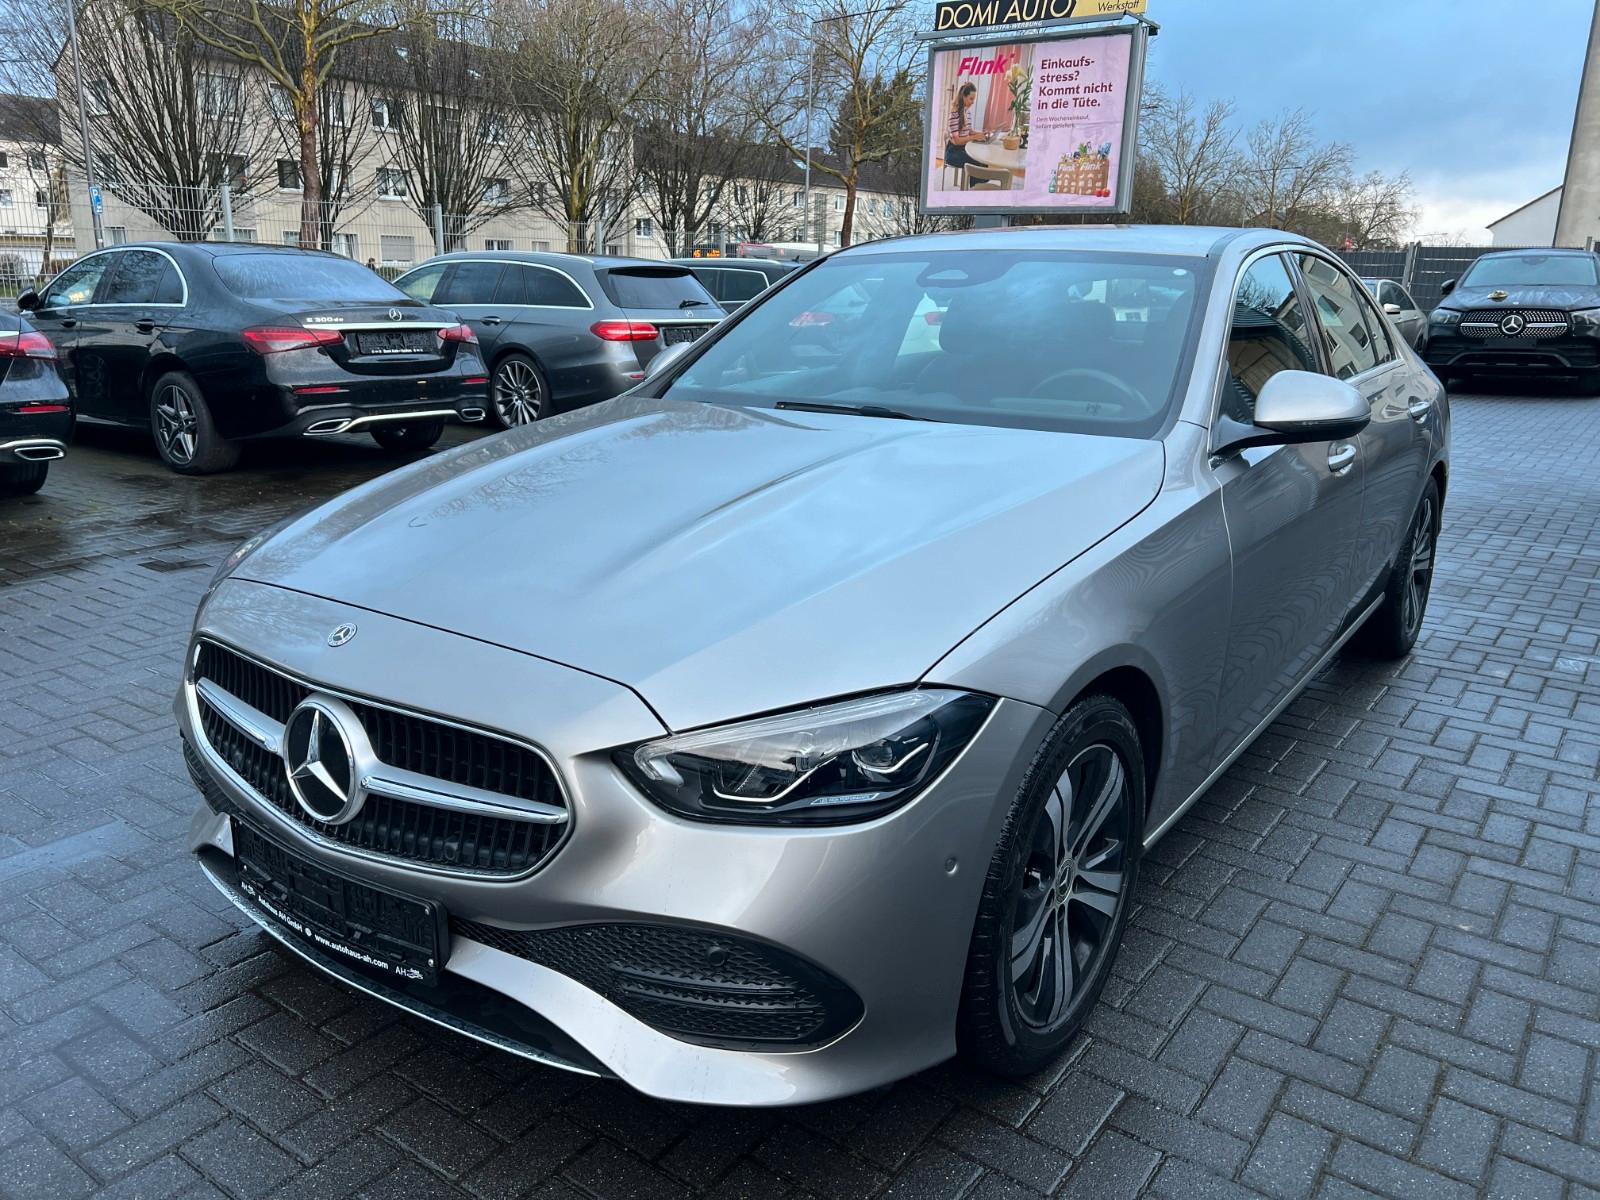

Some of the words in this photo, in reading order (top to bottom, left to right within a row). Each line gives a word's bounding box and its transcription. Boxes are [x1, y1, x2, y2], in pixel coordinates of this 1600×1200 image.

[1097, 0, 1140, 12] Werkstatt
[938, 1, 999, 30] DOMI
[1004, 0, 1072, 23] AUTO
[1041, 56, 1095, 70] Einkaufs-
[1040, 70, 1080, 83] stress?
[1039, 84, 1080, 96] Kommt
[1083, 82, 1113, 94] nicht
[1037, 99, 1048, 110] in
[1051, 98, 1069, 109] die
[1072, 96, 1101, 108] Tüte.
[314, 934, 389, 970] www.autohaus-ah.com
